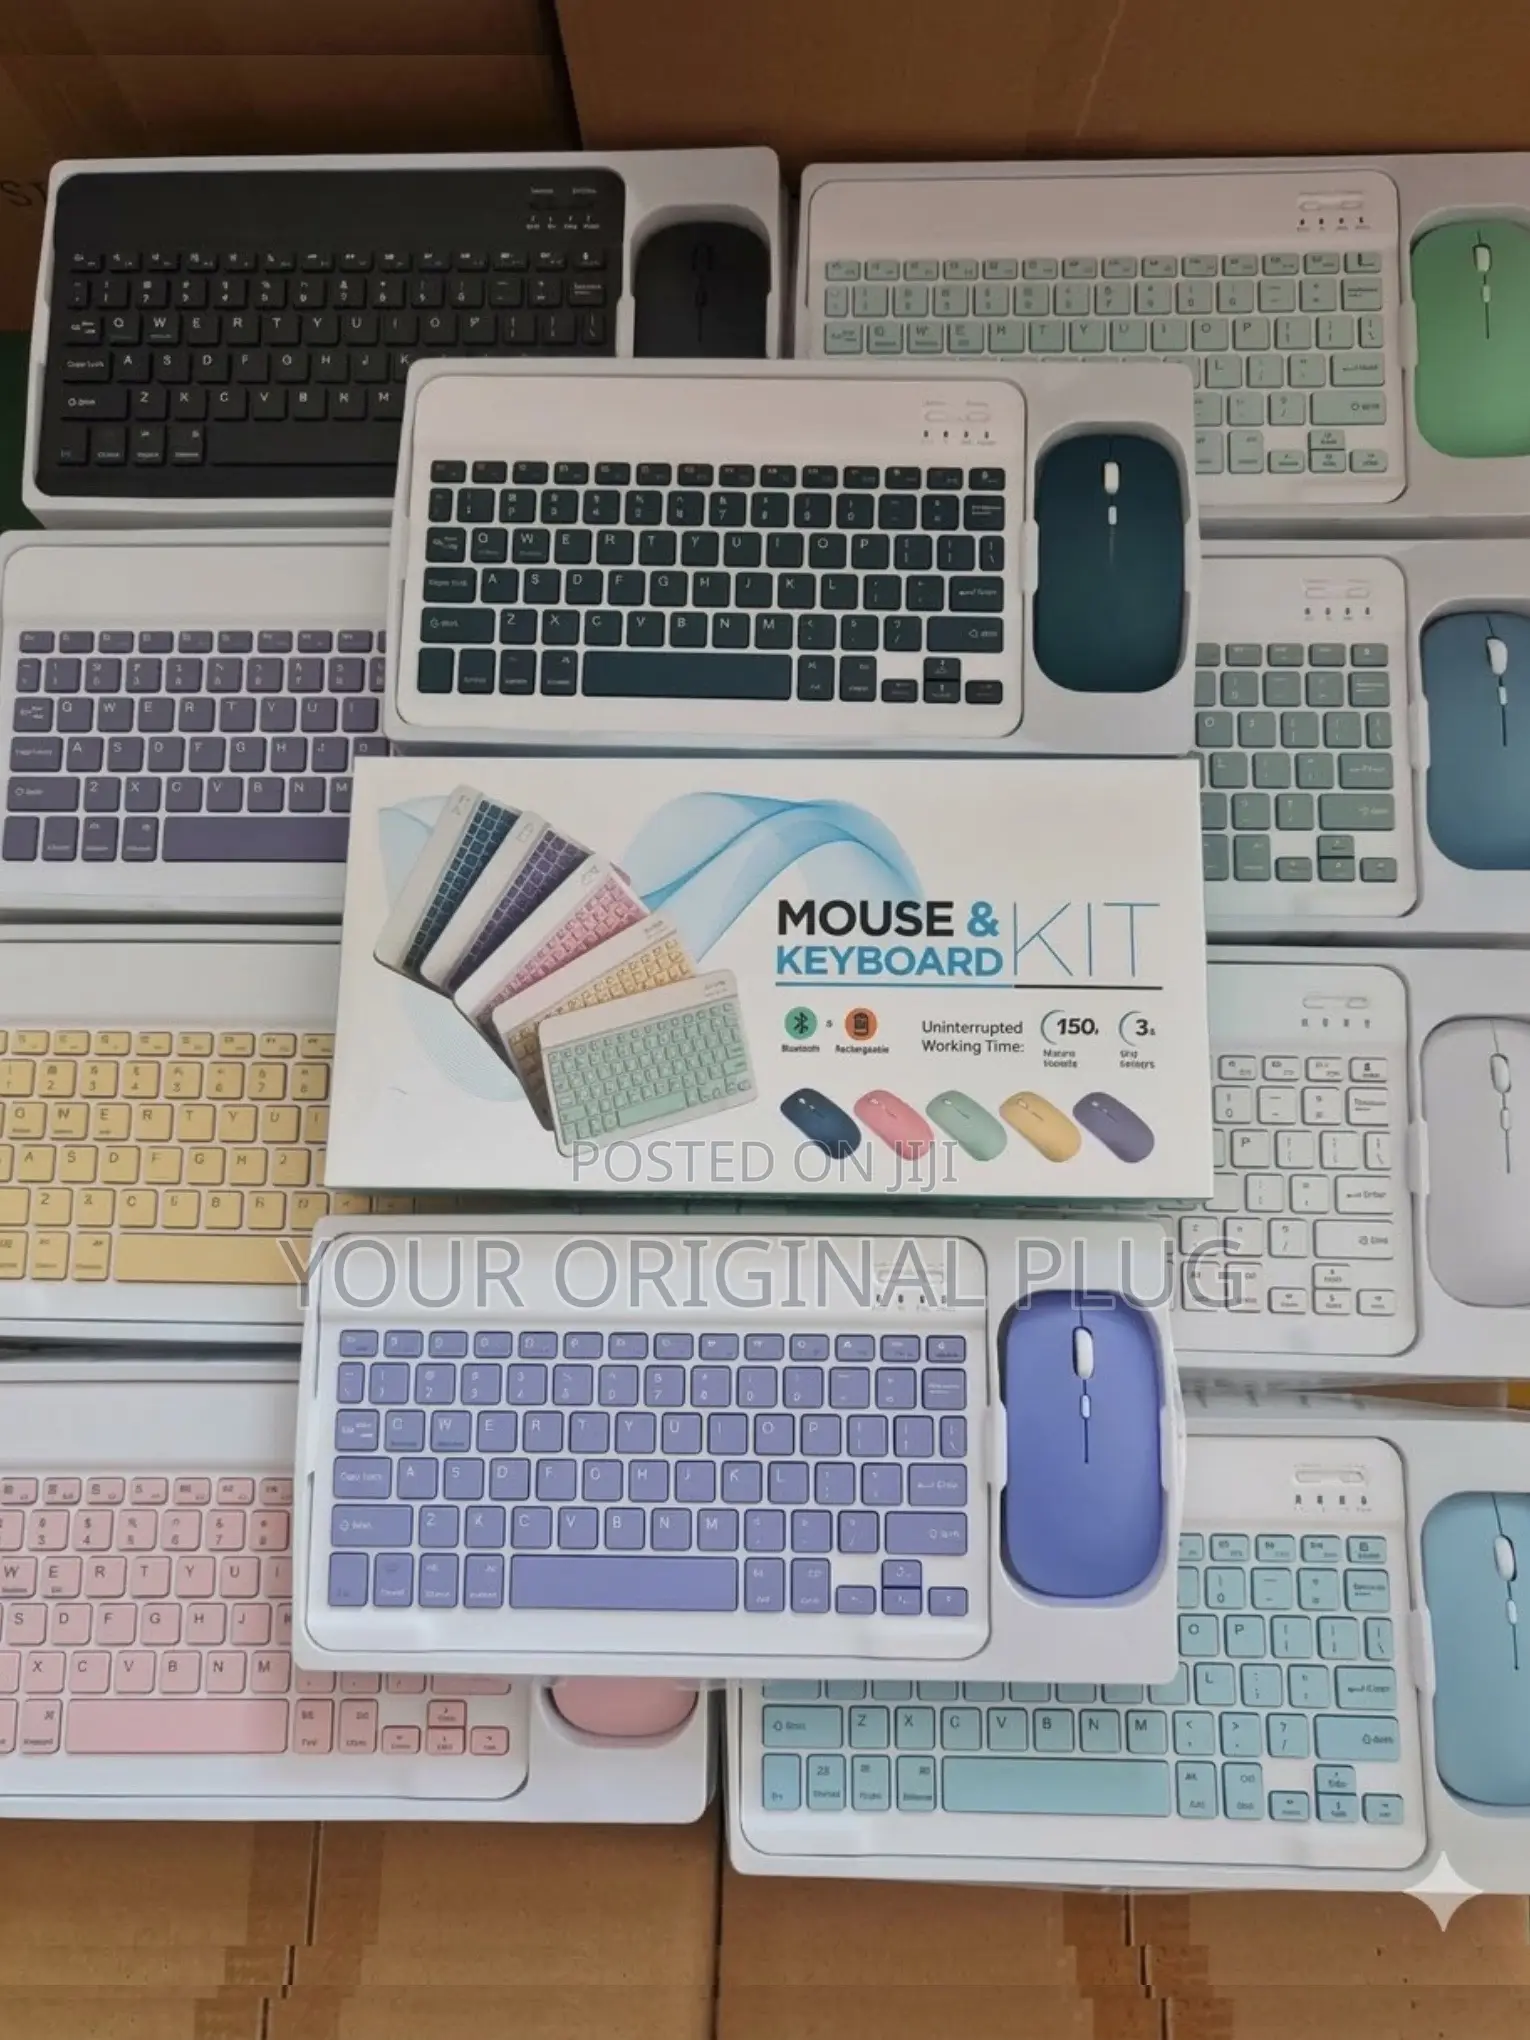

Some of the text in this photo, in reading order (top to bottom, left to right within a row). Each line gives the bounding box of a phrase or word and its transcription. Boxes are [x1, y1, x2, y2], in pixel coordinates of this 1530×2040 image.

[777, 899, 1000, 938] MOUSE &
[1013, 901, 1160, 978] KIT
[776, 945, 1003, 977] KEYBOARD
[921, 1020, 1024, 1037] Uninterrupted
[921, 1039, 1025, 1056] Working Time:
[38, 1534, 46, 1545] 3
[83, 1535, 90, 1545] 4
[216, 1534, 223, 1545] 7
[4, 1566, 19, 1578] W
[49, 1565, 58, 1578] E
[95, 1565, 105, 1578] R
[140, 1565, 149, 1577] T
[185, 1565, 194, 1577] Y
[230, 1566, 240, 1578] U
[14, 1612, 24, 1625] S
[59, 1612, 69, 1624] D
[104, 1612, 112, 1624] F
[149, 1612, 161, 1624] G
[194, 1613, 204, 1623] H
[32, 1660, 270, 1672] X C V B N M
